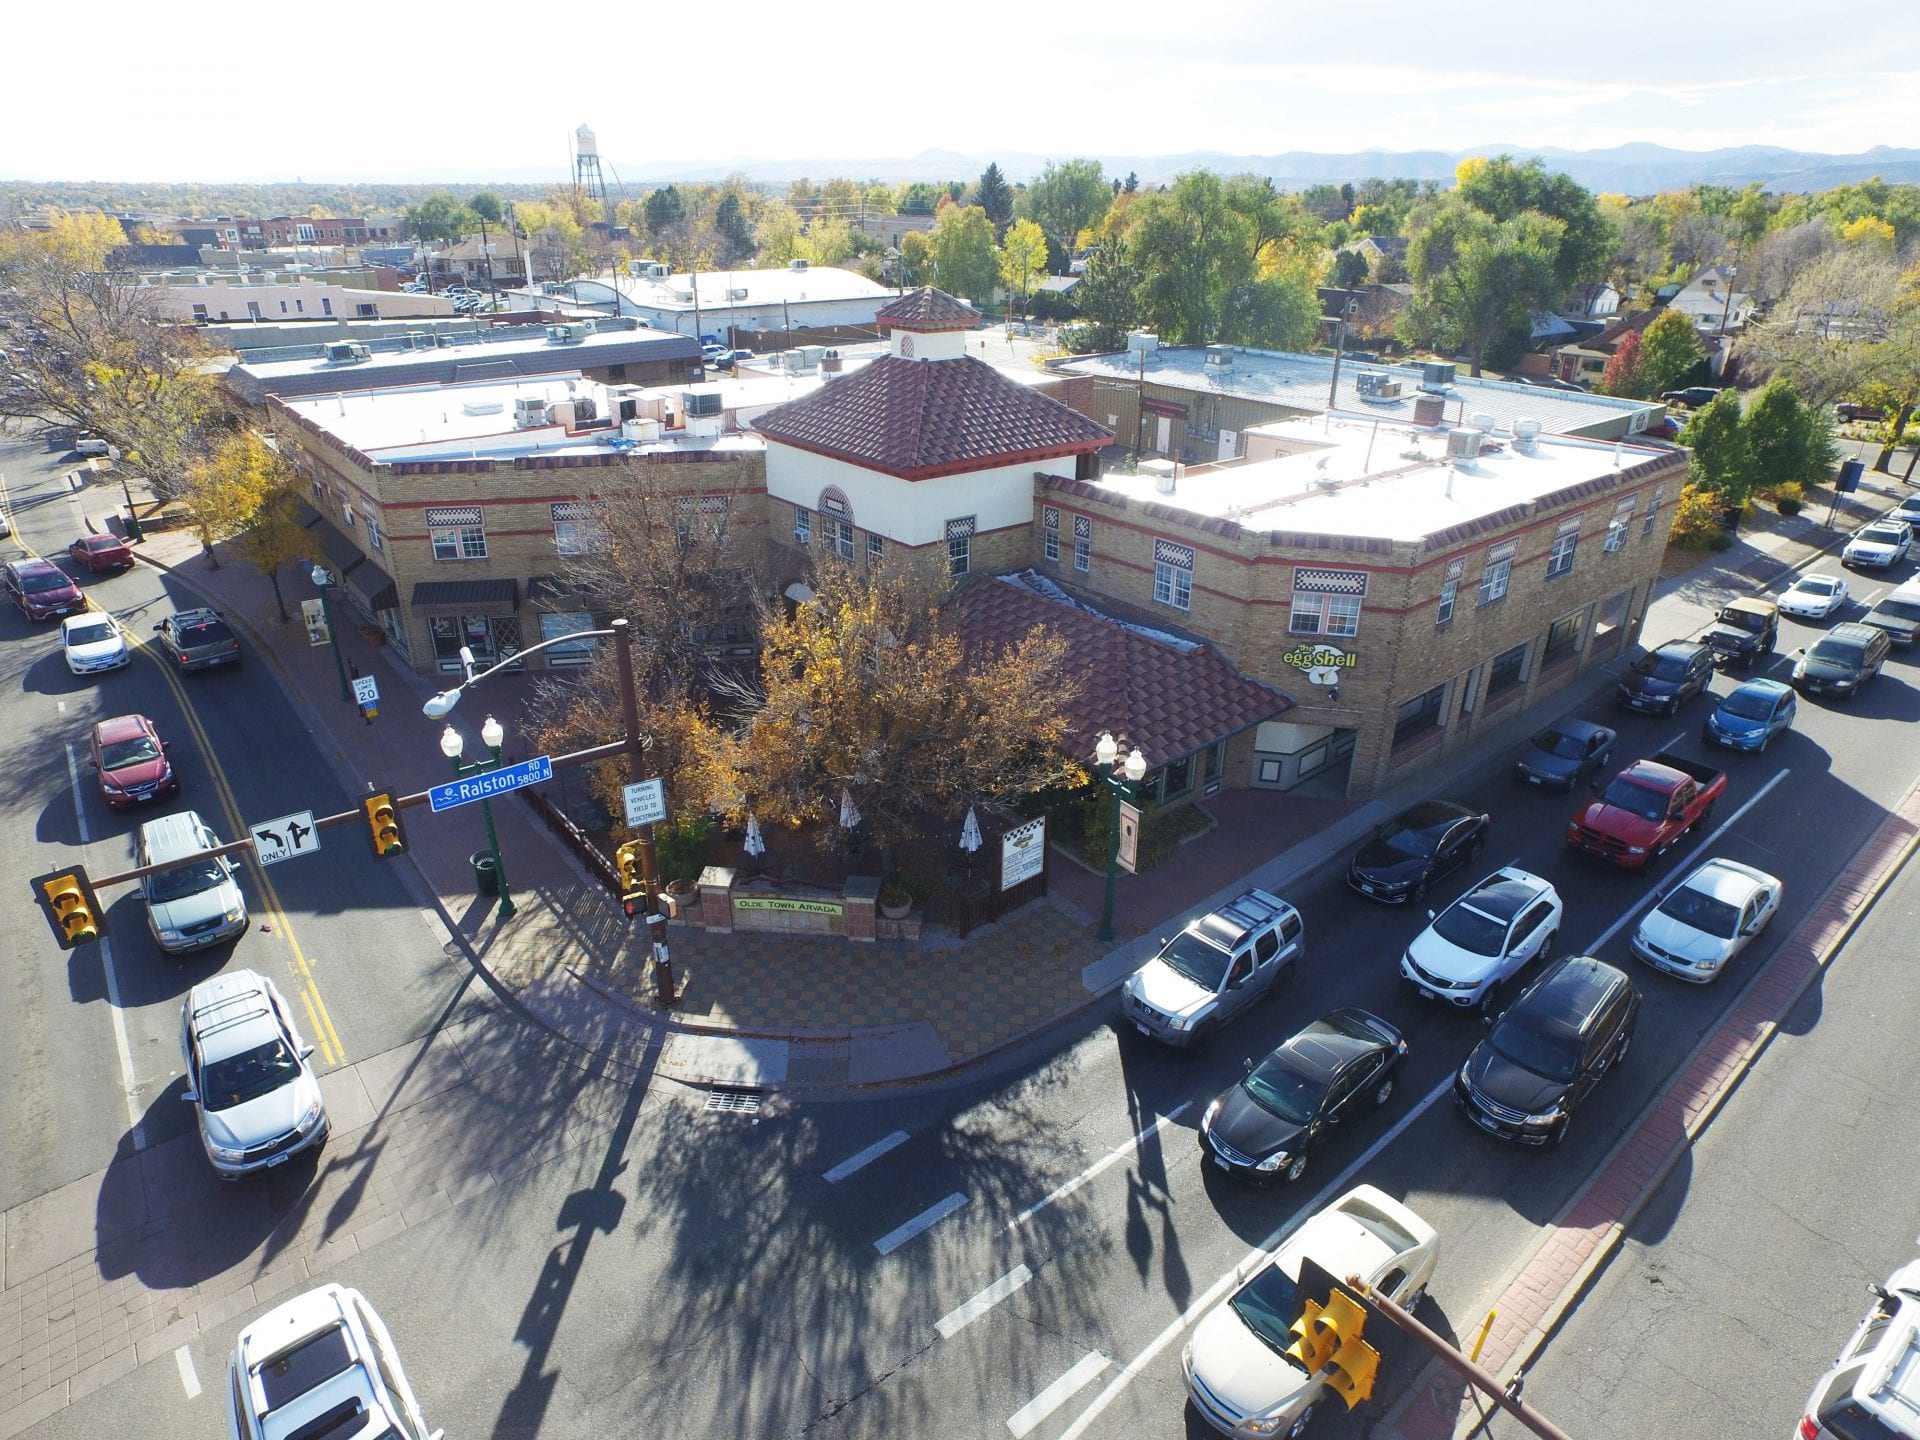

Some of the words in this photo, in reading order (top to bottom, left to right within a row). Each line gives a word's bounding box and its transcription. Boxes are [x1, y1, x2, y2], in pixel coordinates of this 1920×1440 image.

[359, 690, 375, 701] 20
[528, 760, 540, 772] RD
[460, 774, 515, 799] Ralston
[517, 772, 541, 786] 5800
[543, 767, 551, 777] N
[631, 784, 654, 794] TURNING
[630, 793, 656, 803] VEHICLES
[633, 804, 649, 813] YIELD
[261, 848, 287, 862] ONLY
[768, 901, 795, 910] TOWN
[798, 903, 837, 913] ARVADA
